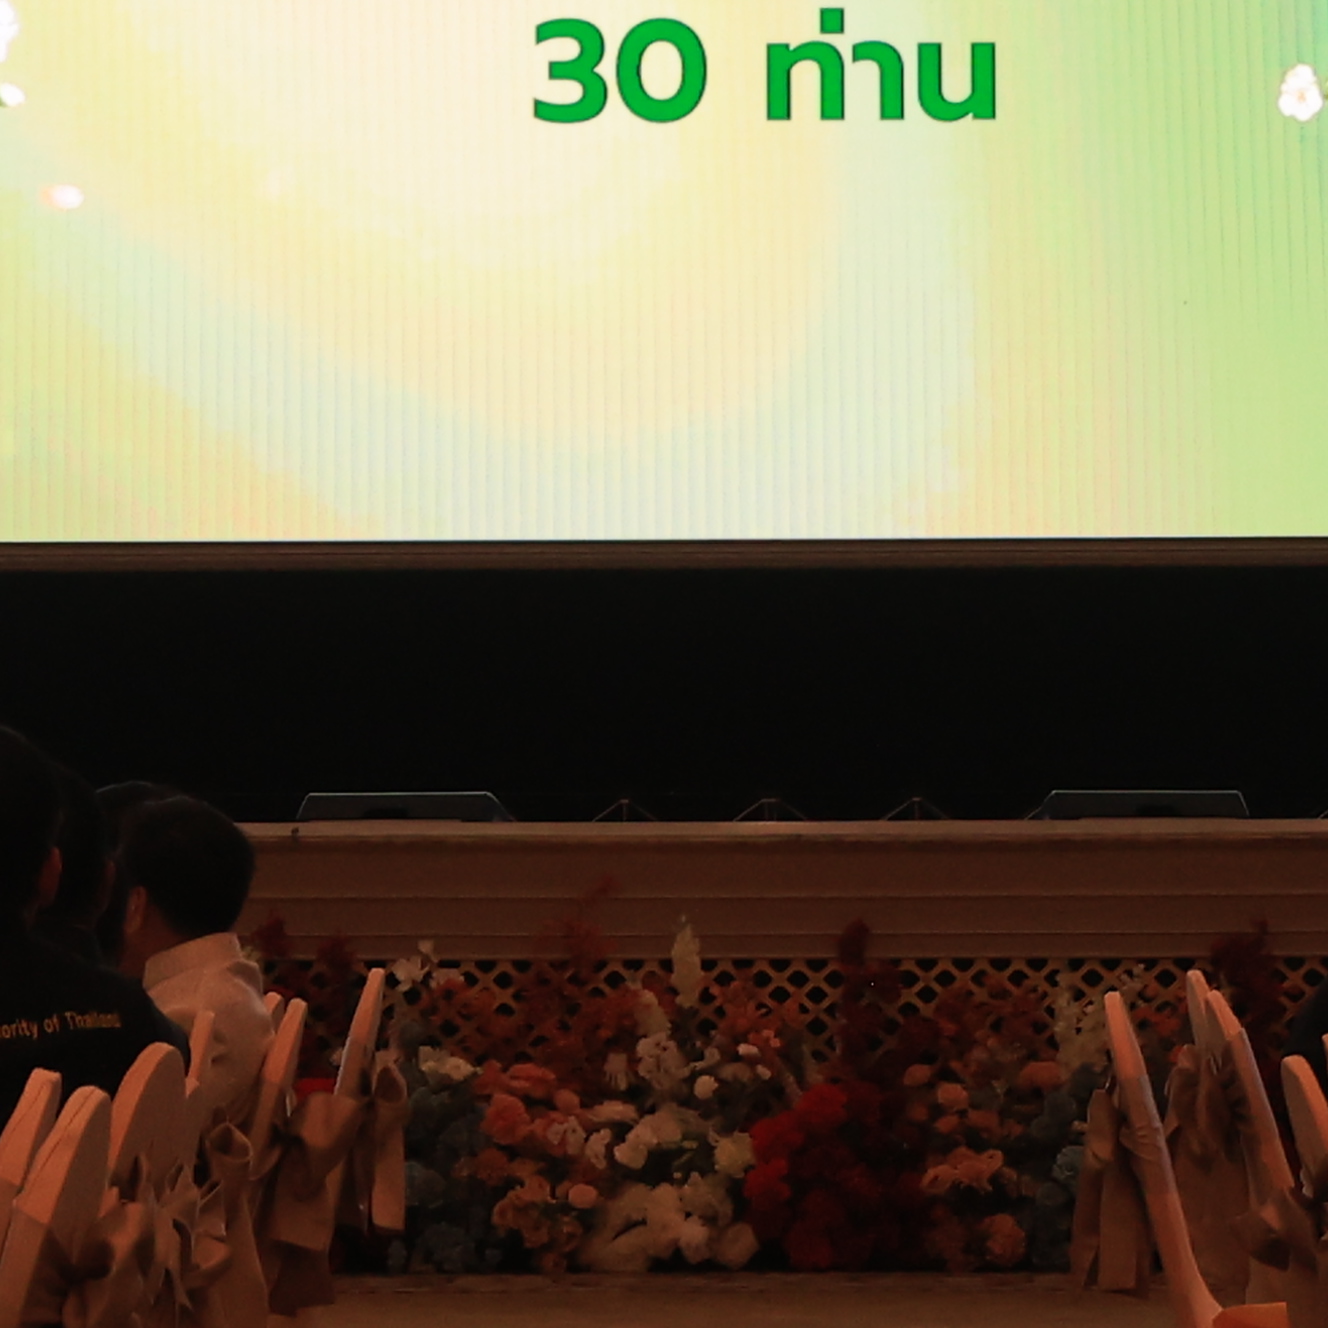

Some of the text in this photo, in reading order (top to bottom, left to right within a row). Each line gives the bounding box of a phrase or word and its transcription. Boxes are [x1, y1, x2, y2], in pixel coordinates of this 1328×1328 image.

[534, 7, 997, 123] 30 ท่าน
[43, 1014, 61, 1034] of
